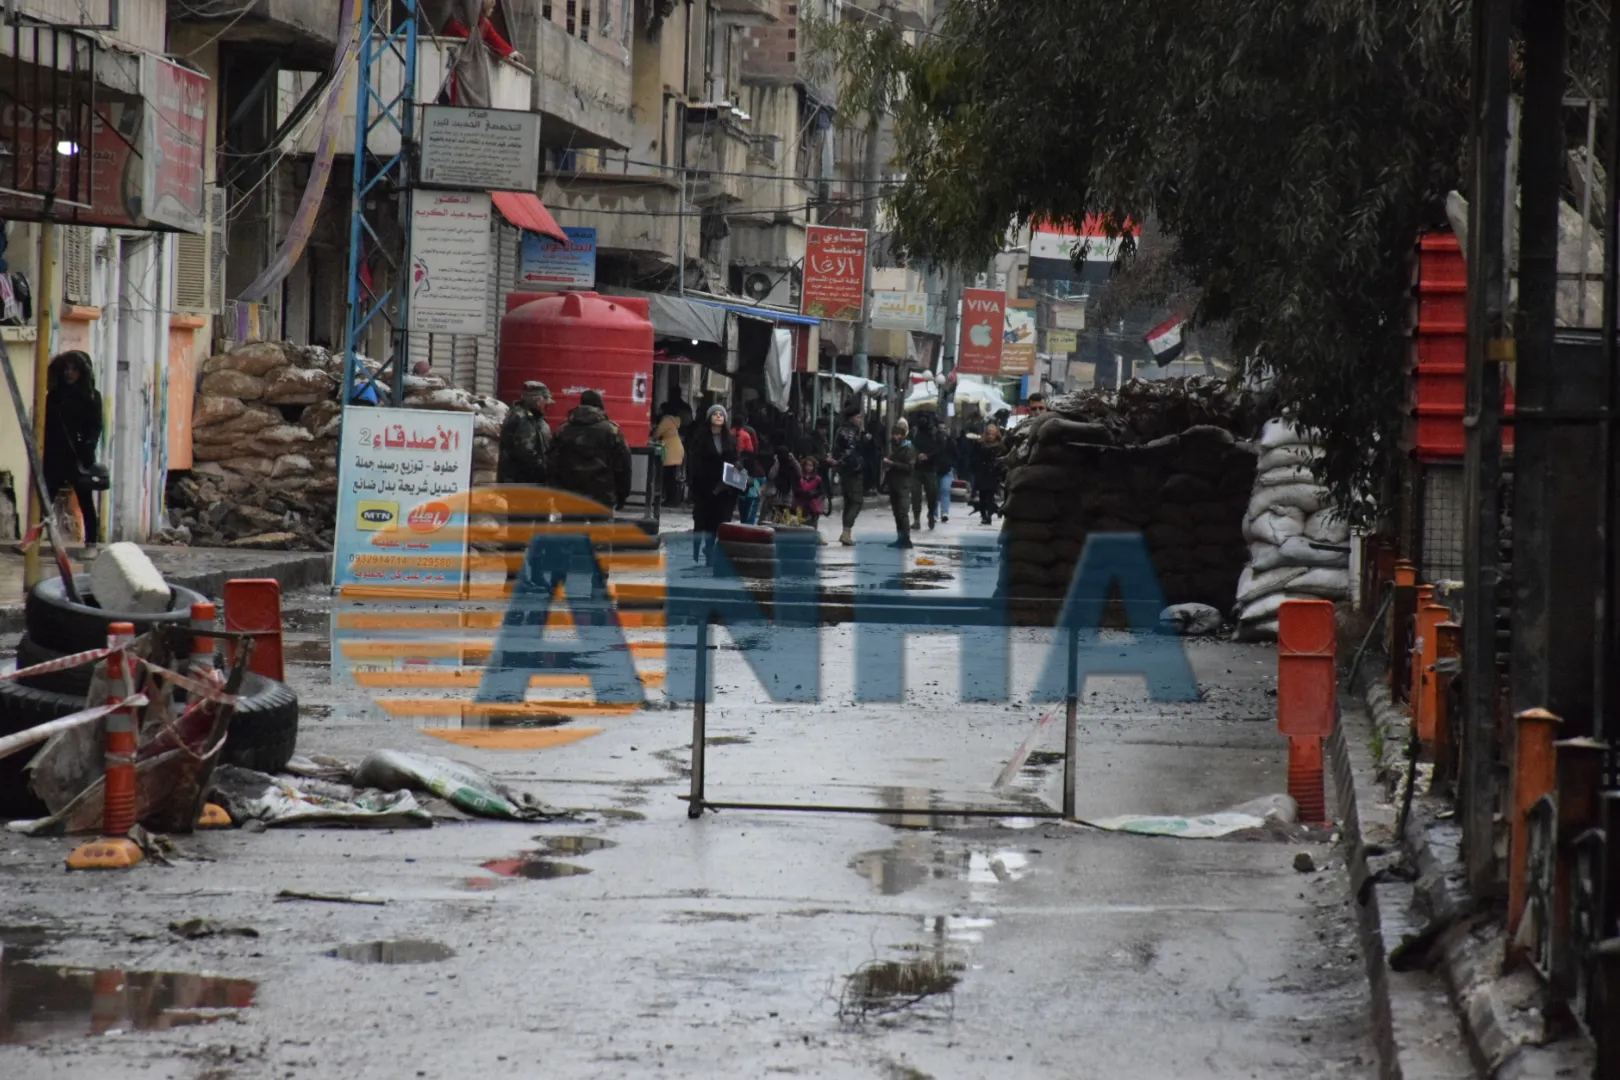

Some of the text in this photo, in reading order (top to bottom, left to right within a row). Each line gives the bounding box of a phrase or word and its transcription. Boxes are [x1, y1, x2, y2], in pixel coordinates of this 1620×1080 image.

[823, 232, 864, 244] مشاوي
[967, 299, 1001, 313] VIVA
[373, 424, 459, 450] الأصدقاء
[355, 456, 375, 471] جملة
[377, 460, 399, 472] رصيد
[400, 459, 424, 475] توزيع
[433, 461, 459, 475] خطوط
[353, 477, 458, 497] تبديل شريحة بدل ضائع
[363, 511, 391, 520] MTN
[417, 556, 452, 568] 229580
